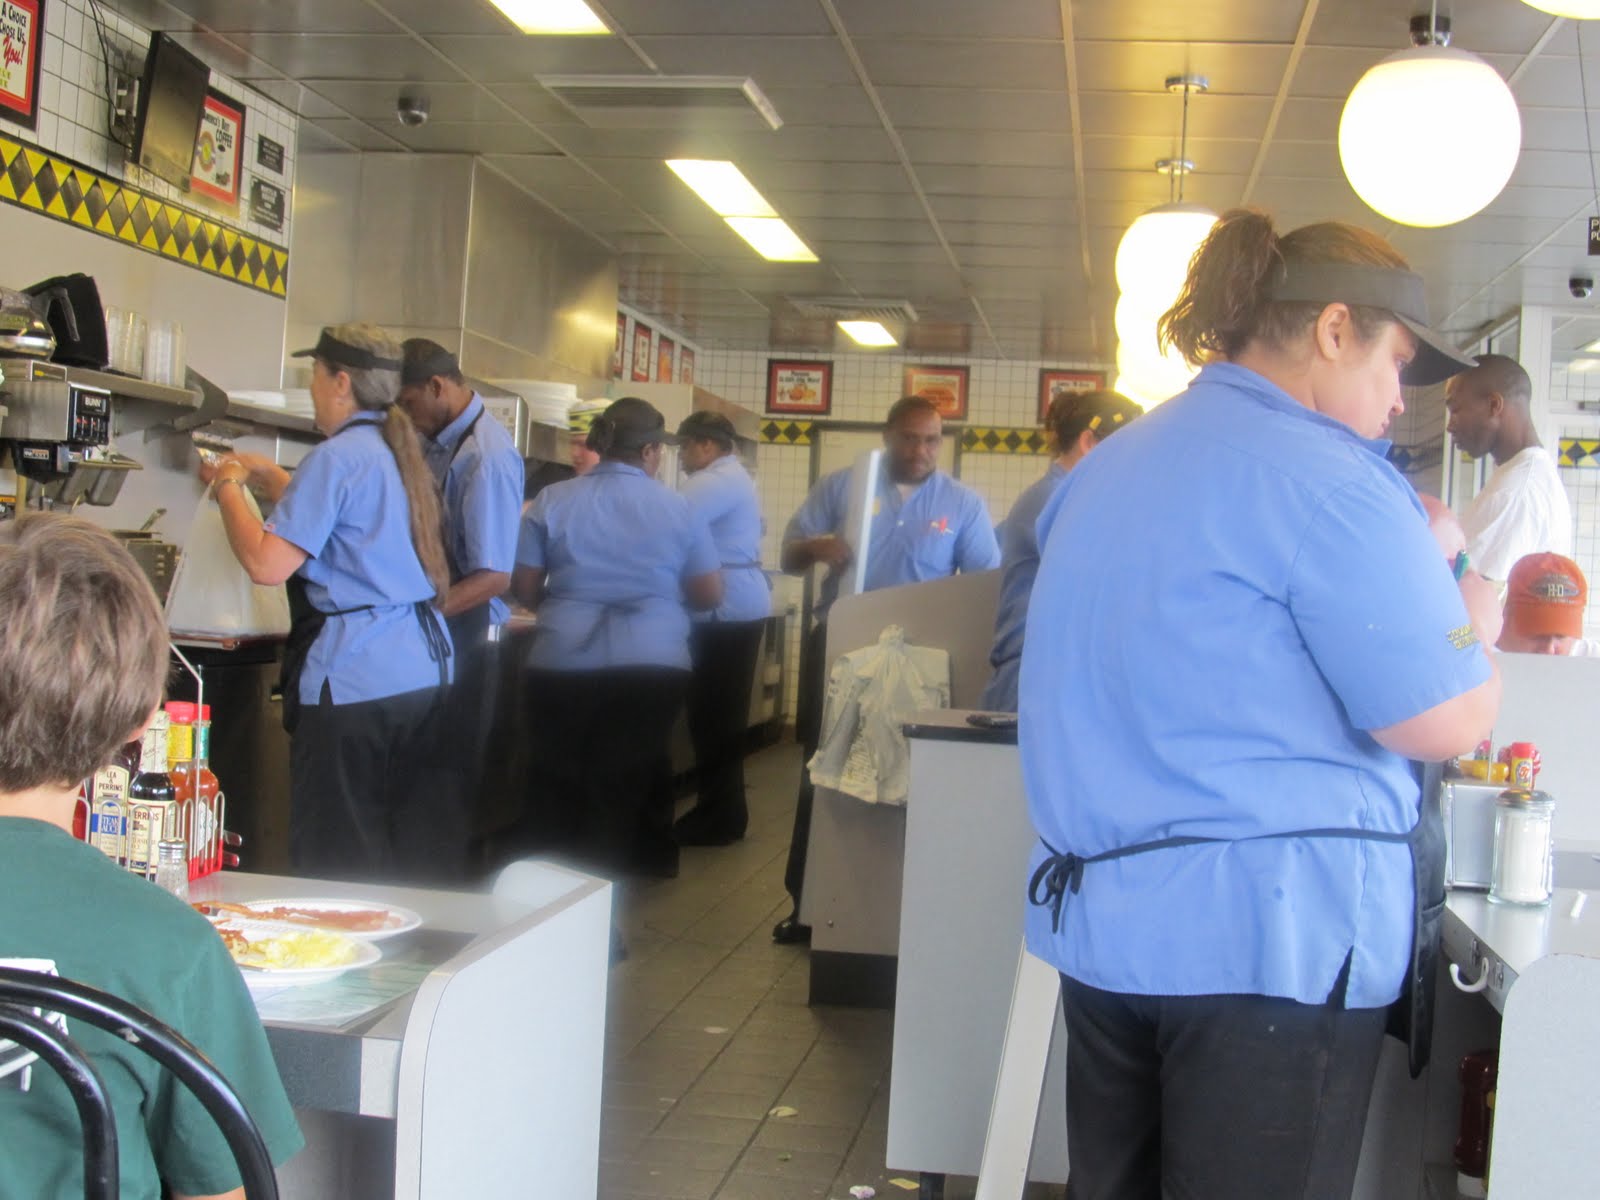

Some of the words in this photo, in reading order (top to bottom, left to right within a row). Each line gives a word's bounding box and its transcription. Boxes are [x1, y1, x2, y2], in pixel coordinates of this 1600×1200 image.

[2, 2, 7, 17] A
[8, 5, 27, 28] CHOICE
[85, 396, 101, 407] BUNN
[98, 782, 123, 791] PERRINS
[128, 810, 160, 822] ERRIS
